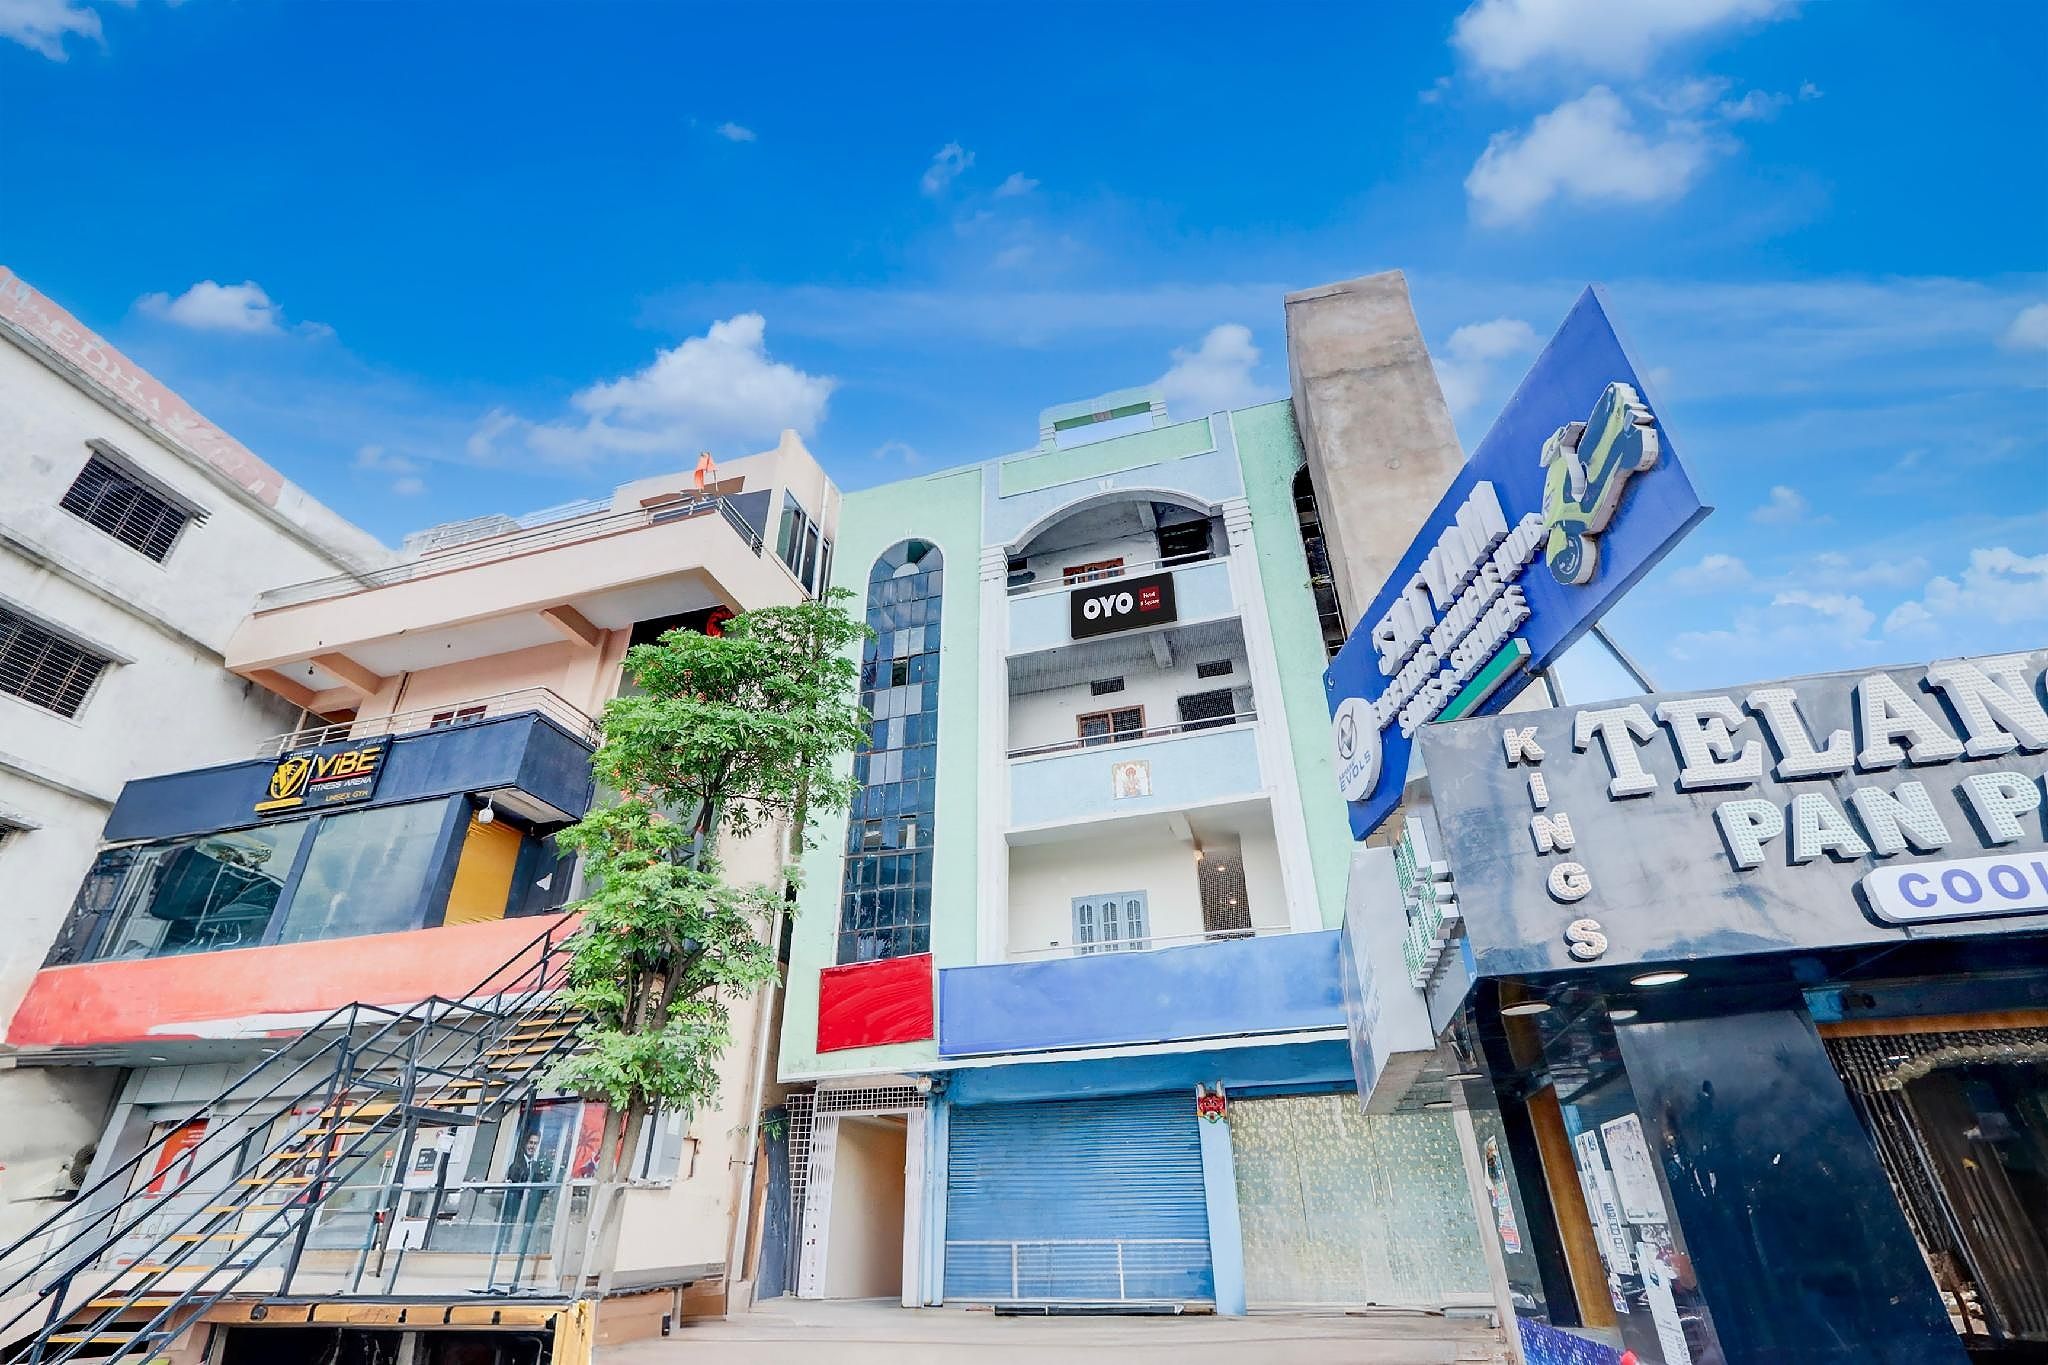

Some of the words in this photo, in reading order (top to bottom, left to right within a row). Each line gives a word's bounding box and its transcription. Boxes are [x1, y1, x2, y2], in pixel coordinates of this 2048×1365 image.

[1083, 592, 1133, 620] OYO
[1451, 585, 1531, 680] SERVICE
[1339, 750, 1371, 792] EVOLS
[1574, 656, 2048, 798] TELAN
[309, 781, 342, 793] FITNESS
[343, 777, 372, 788] ARENA
[1716, 781, 1952, 868] PAN
[1960, 771, 2048, 844] P
[1503, 726, 1608, 960] KINGS
